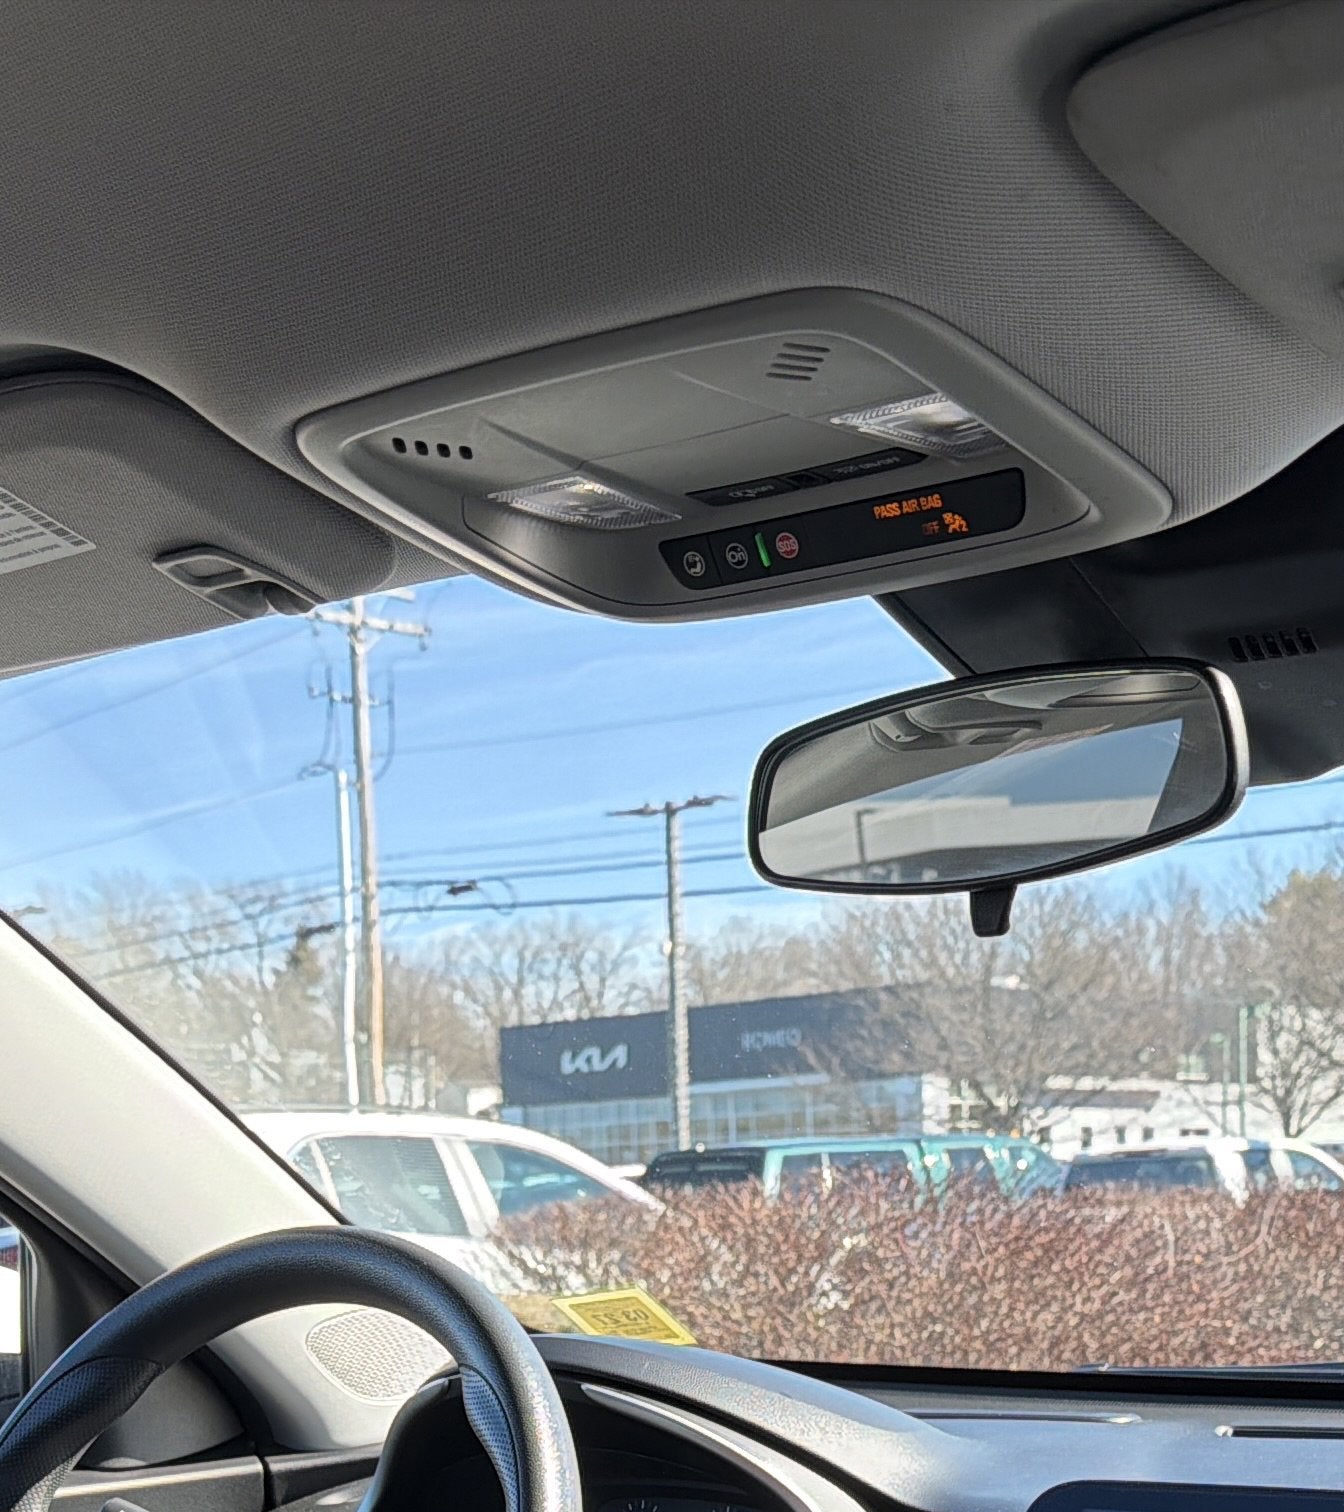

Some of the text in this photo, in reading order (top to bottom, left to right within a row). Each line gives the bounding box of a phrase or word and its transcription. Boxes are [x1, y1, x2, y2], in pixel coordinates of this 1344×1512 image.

[873, 493, 942, 520] PASS AIR BAG
[922, 521, 940, 536] OFF
[778, 538, 797, 553] SOS
[728, 546, 746, 563] On
